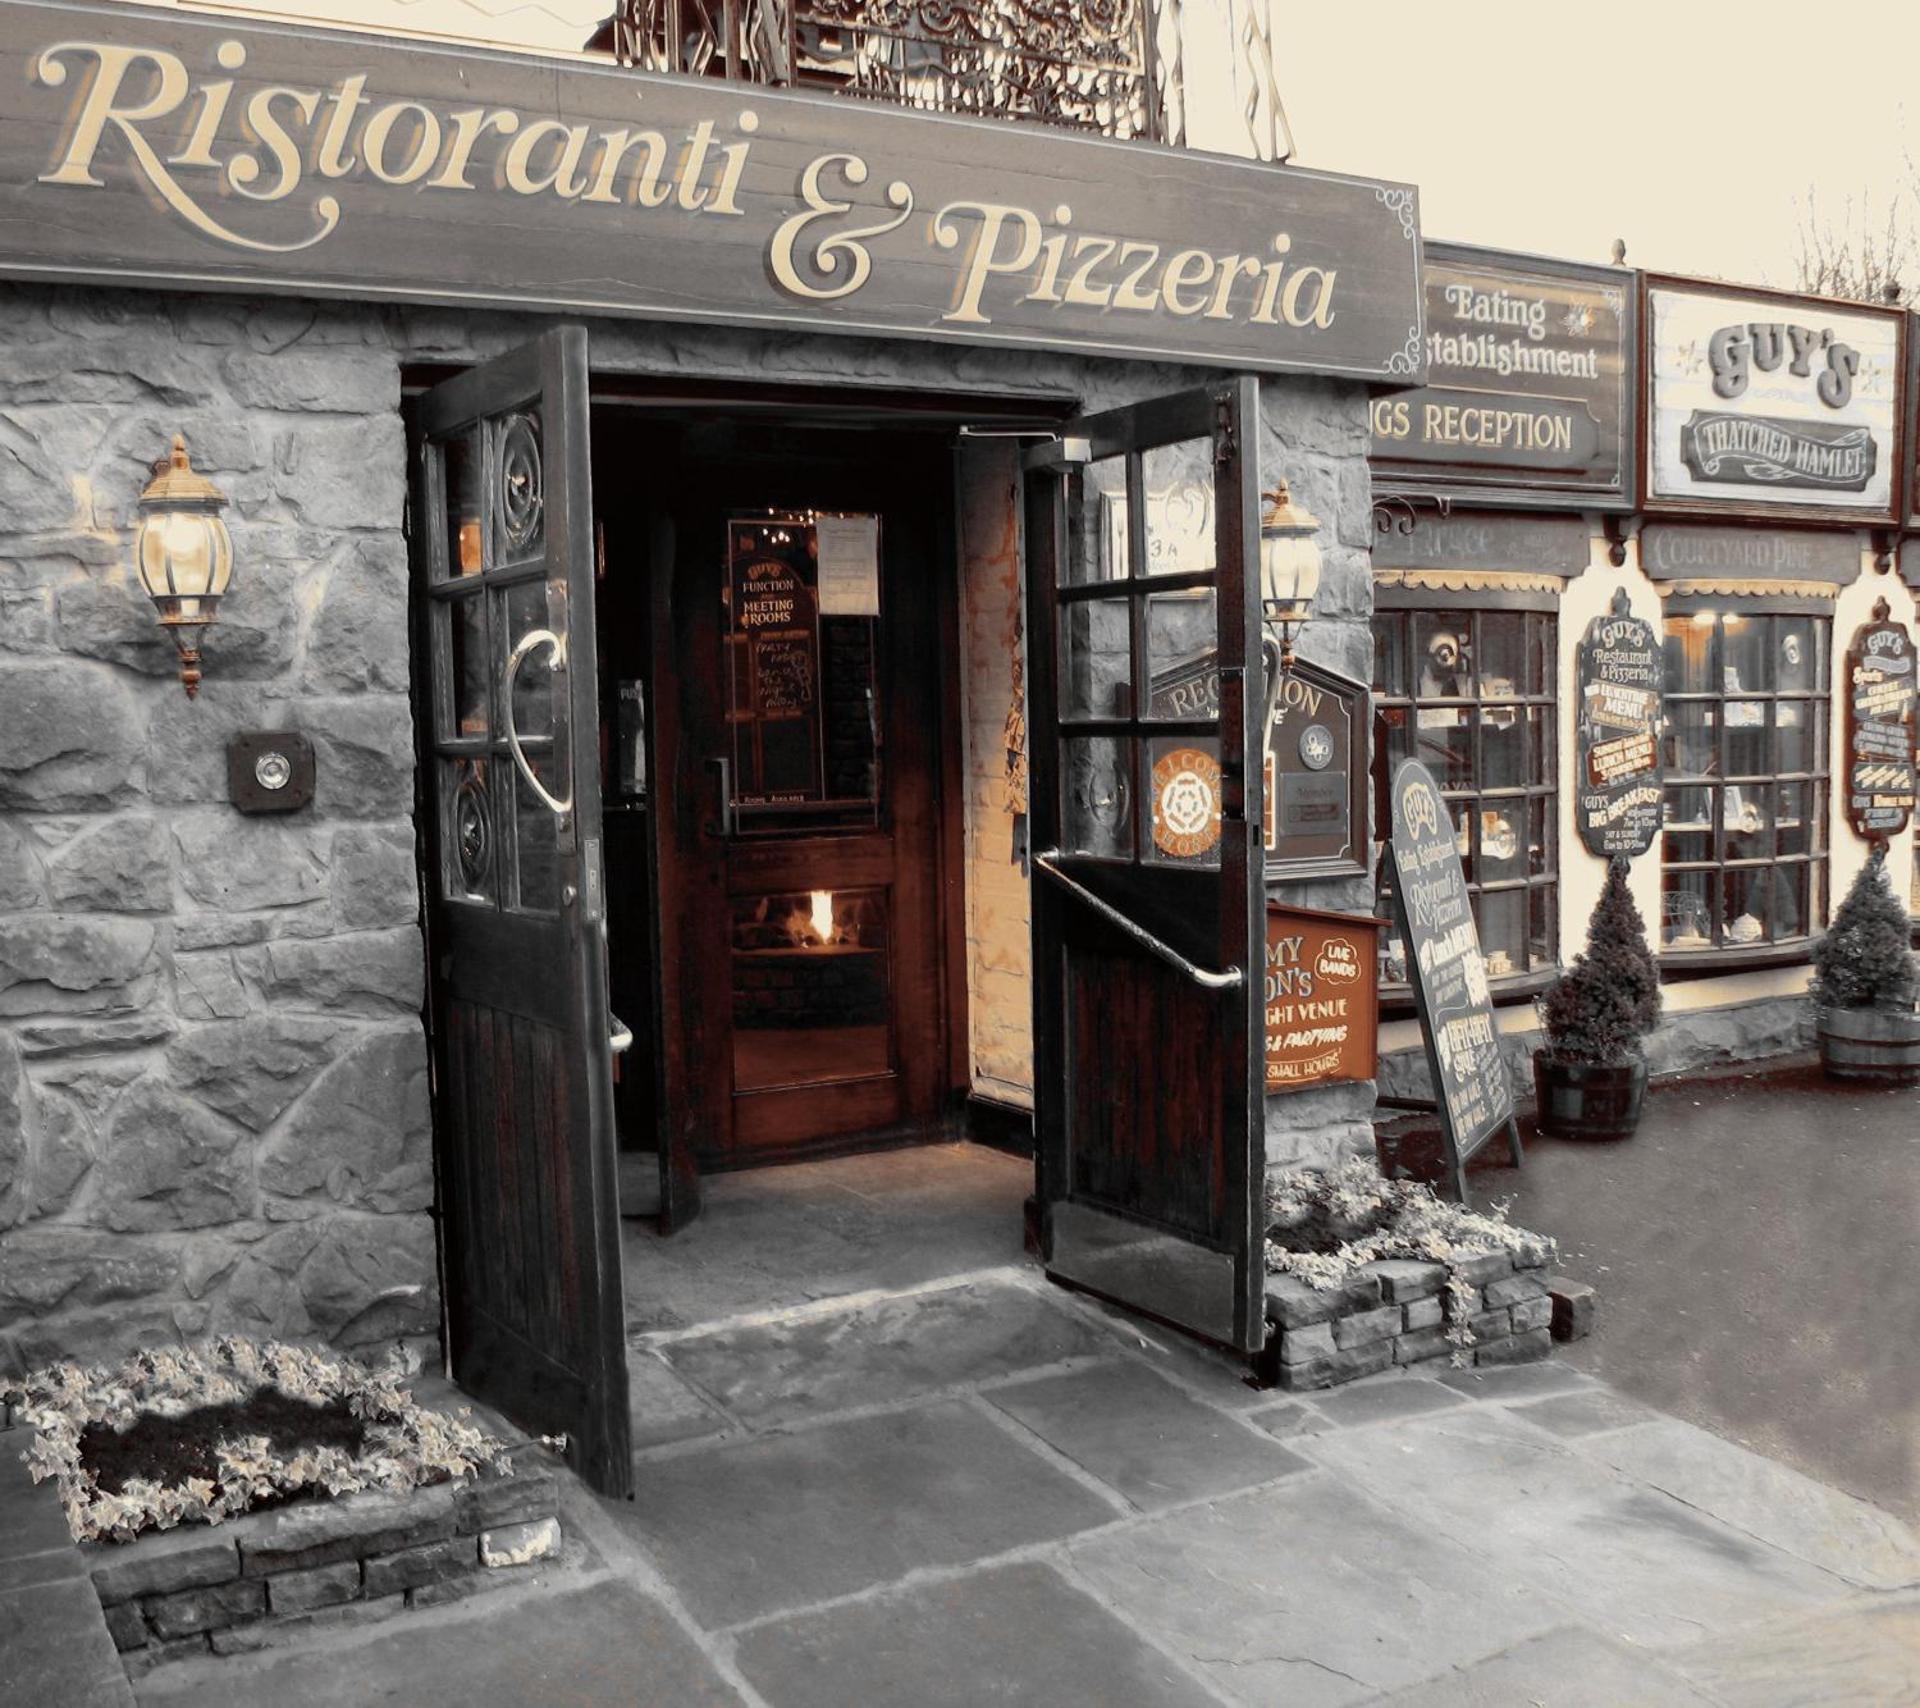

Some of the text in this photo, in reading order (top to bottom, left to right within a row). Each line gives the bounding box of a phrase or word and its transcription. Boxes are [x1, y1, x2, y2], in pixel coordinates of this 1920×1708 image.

[38, 40, 1337, 329] Ristoranti & Pizzeria
[1445, 284, 1546, 341] Eating
[1707, 322, 1861, 410] GUY'S
[1425, 403, 1572, 450] RECEPTION
[1703, 420, 1868, 479] THATCHED HAMLET
[742, 580, 795, 594] FUNCTION
[743, 599, 795, 616] MEETING
[750, 611, 791, 626] ROOMS
[1592, 648, 1653, 666] Restaurant
[1588, 810, 1608, 828] BIG
[1607, 787, 1662, 822] BREAKFAST
[1327, 945, 1351, 961] LIVE
[1318, 958, 1357, 978] BANDS
[1297, 998, 1348, 1021] VENUE
[1283, 1024, 1348, 1050] PARTYING
[1266, 1064, 1302, 1078] SMALL
